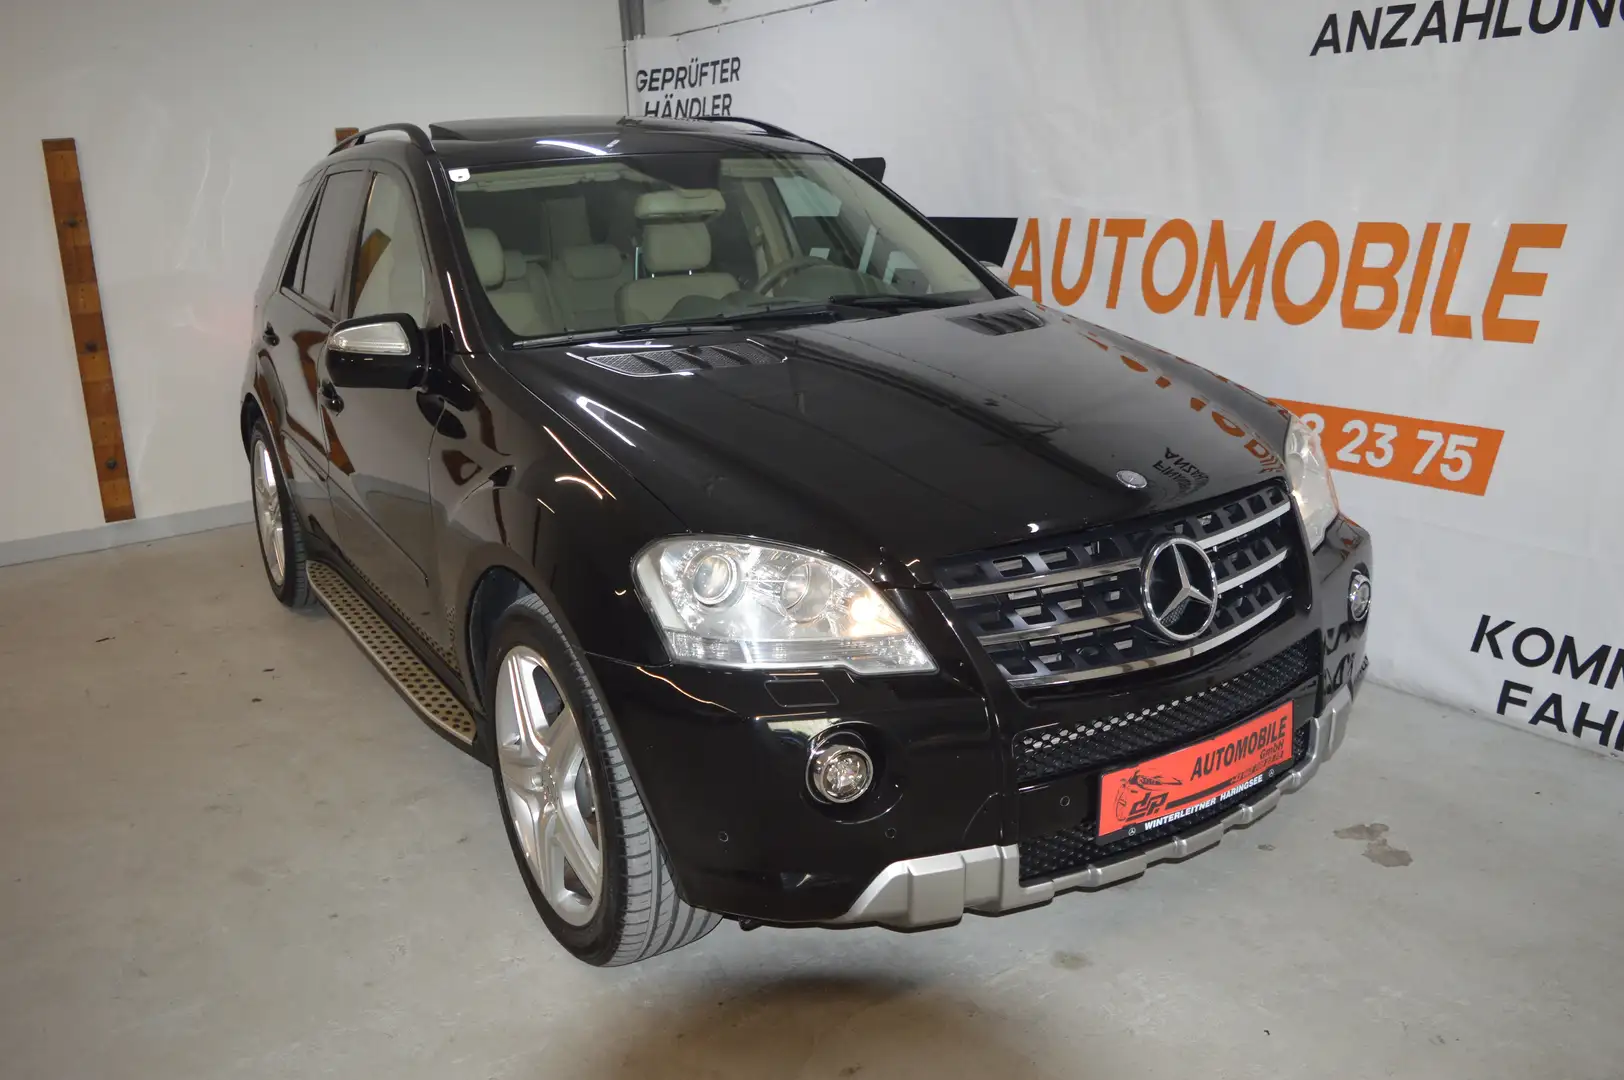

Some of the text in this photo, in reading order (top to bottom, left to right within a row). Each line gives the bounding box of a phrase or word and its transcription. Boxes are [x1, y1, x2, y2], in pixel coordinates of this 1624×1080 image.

[1309, 0, 1624, 57] ANZAHLUN
[635, 56, 741, 93] GEPRÜFTER
[644, 92, 733, 119] HÄNDLER
[1007, 217, 1568, 344] AUTOMOBILE
[1336, 419, 1398, 468] 23
[1412, 429, 1479, 482] 75
[1497, 680, 1624, 752] FAH
[1190, 715, 1288, 781] AUTOMOBILE
[1259, 738, 1285, 760] GmbH
[1144, 774, 1264, 831] WINTERLEITNER HARINGSEE
